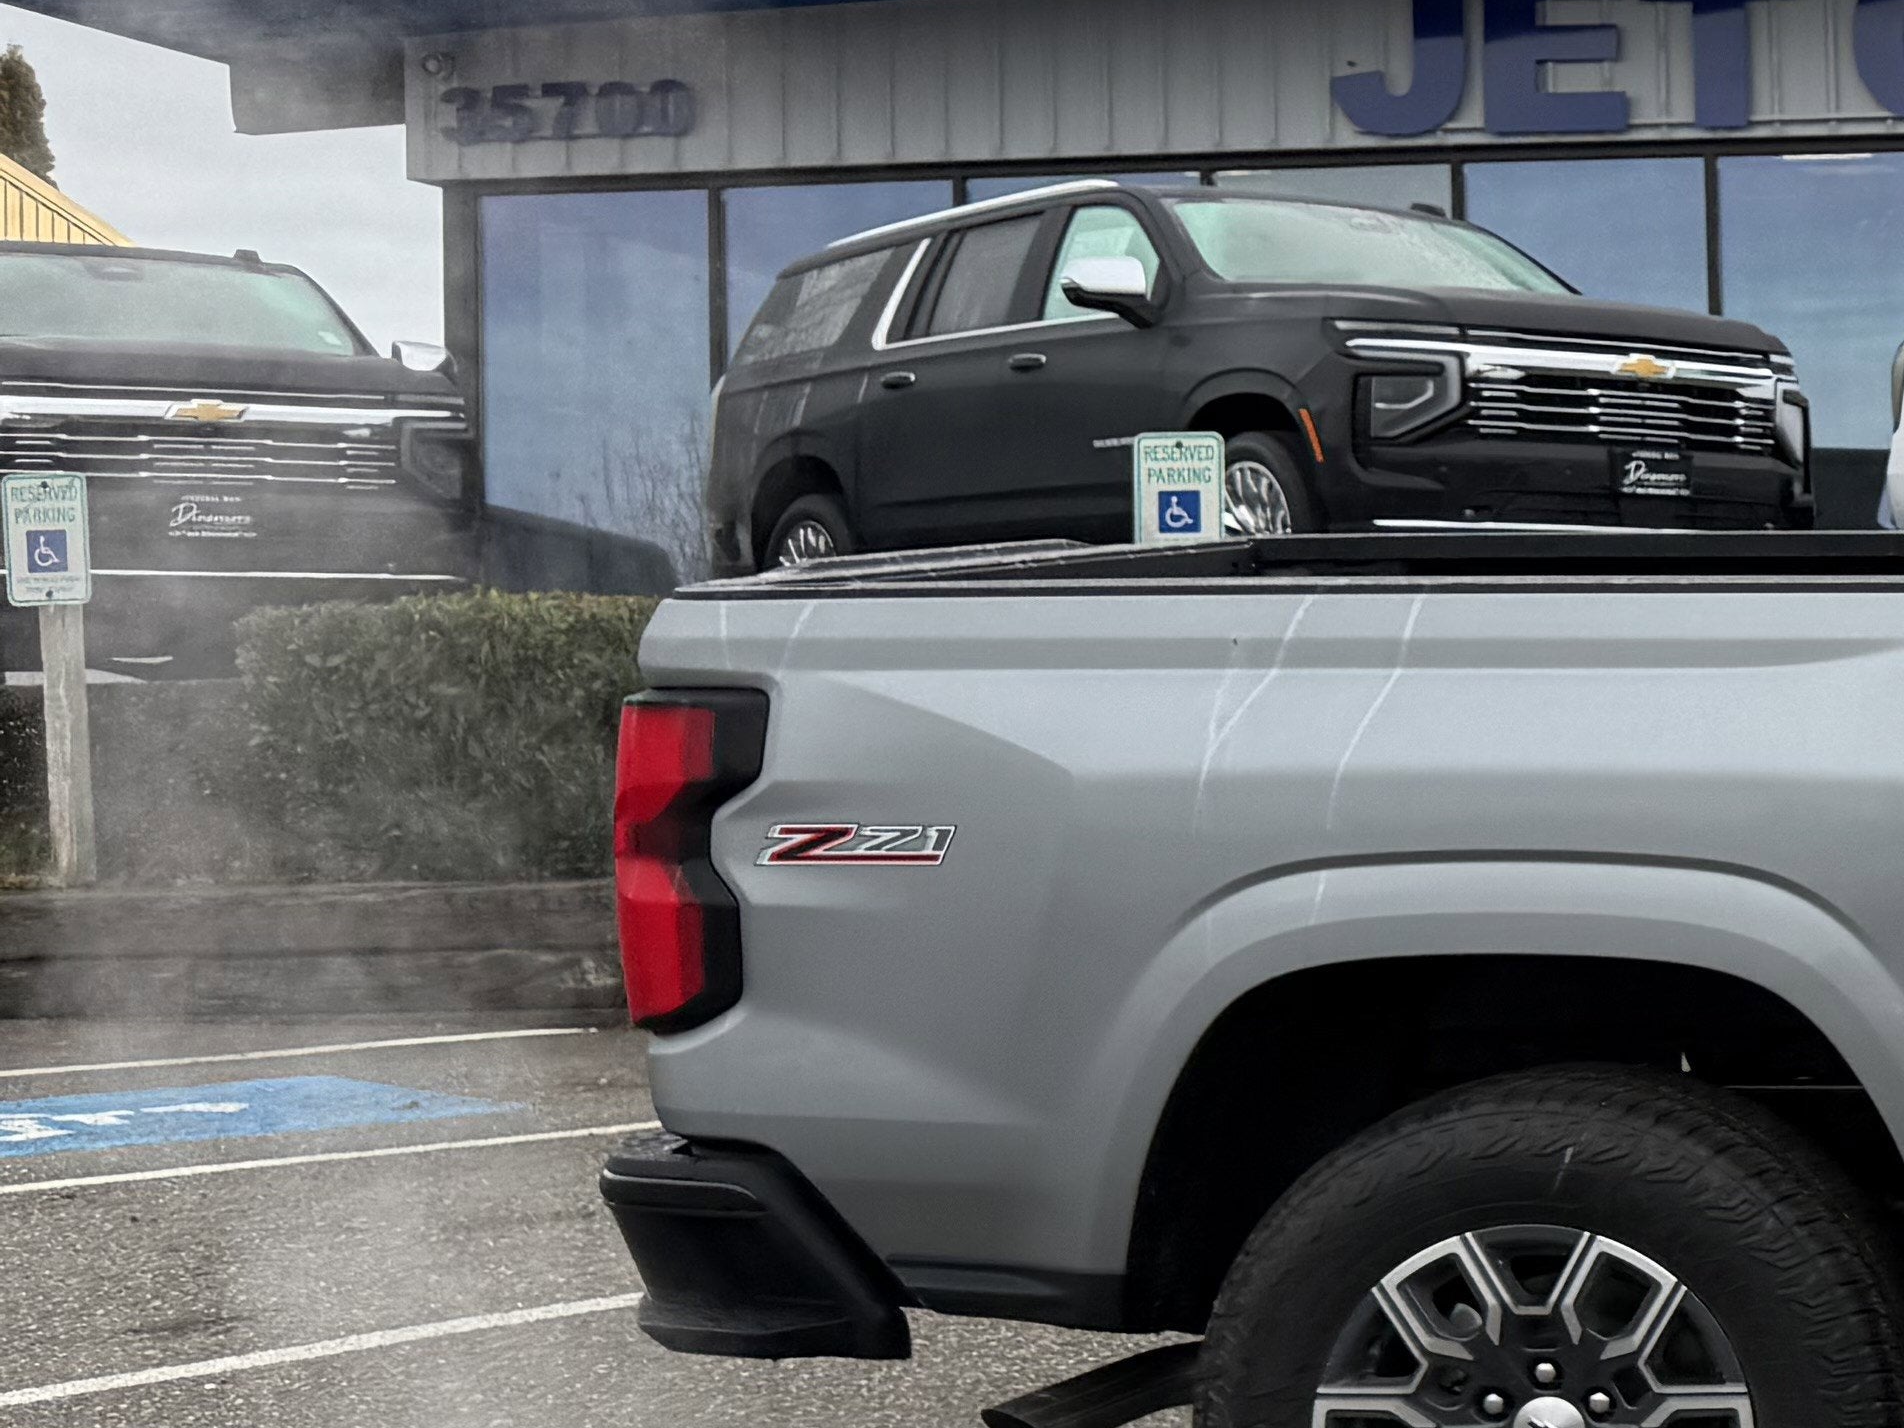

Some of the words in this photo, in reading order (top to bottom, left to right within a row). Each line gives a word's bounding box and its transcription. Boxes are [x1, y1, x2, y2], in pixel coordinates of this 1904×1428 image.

[1143, 444, 1214, 464] RESERVED
[1147, 466, 1212, 484] PARKING
[11, 483, 78, 504] RESERVED
[14, 506, 76, 524] PARKING
[753, 822, 957, 866] Z71
